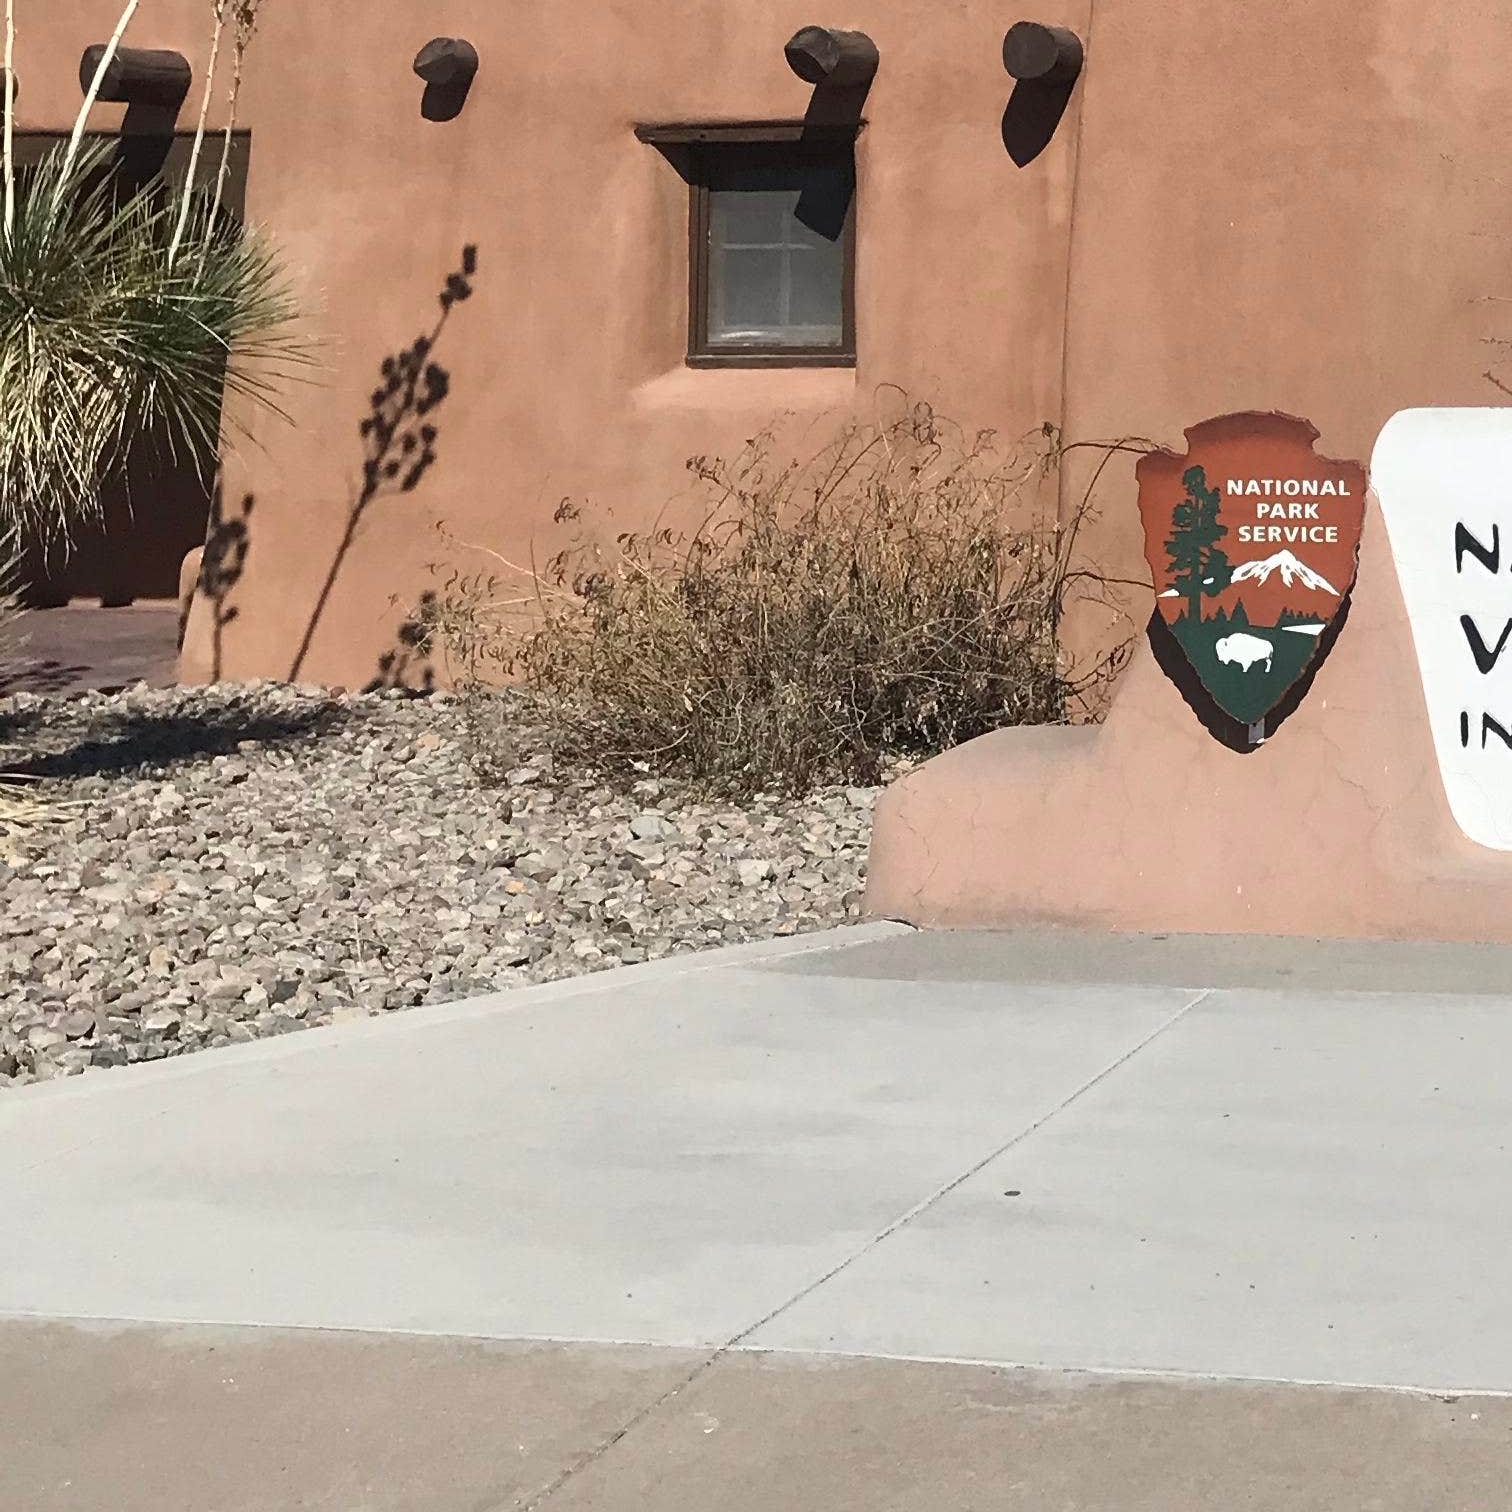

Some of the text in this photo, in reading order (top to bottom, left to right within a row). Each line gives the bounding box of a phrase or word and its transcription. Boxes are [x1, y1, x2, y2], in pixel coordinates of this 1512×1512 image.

[1226, 479, 1351, 497] NATIONAL
[1256, 502, 1320, 520] PARK
[1238, 525, 1338, 543] SERVICE
